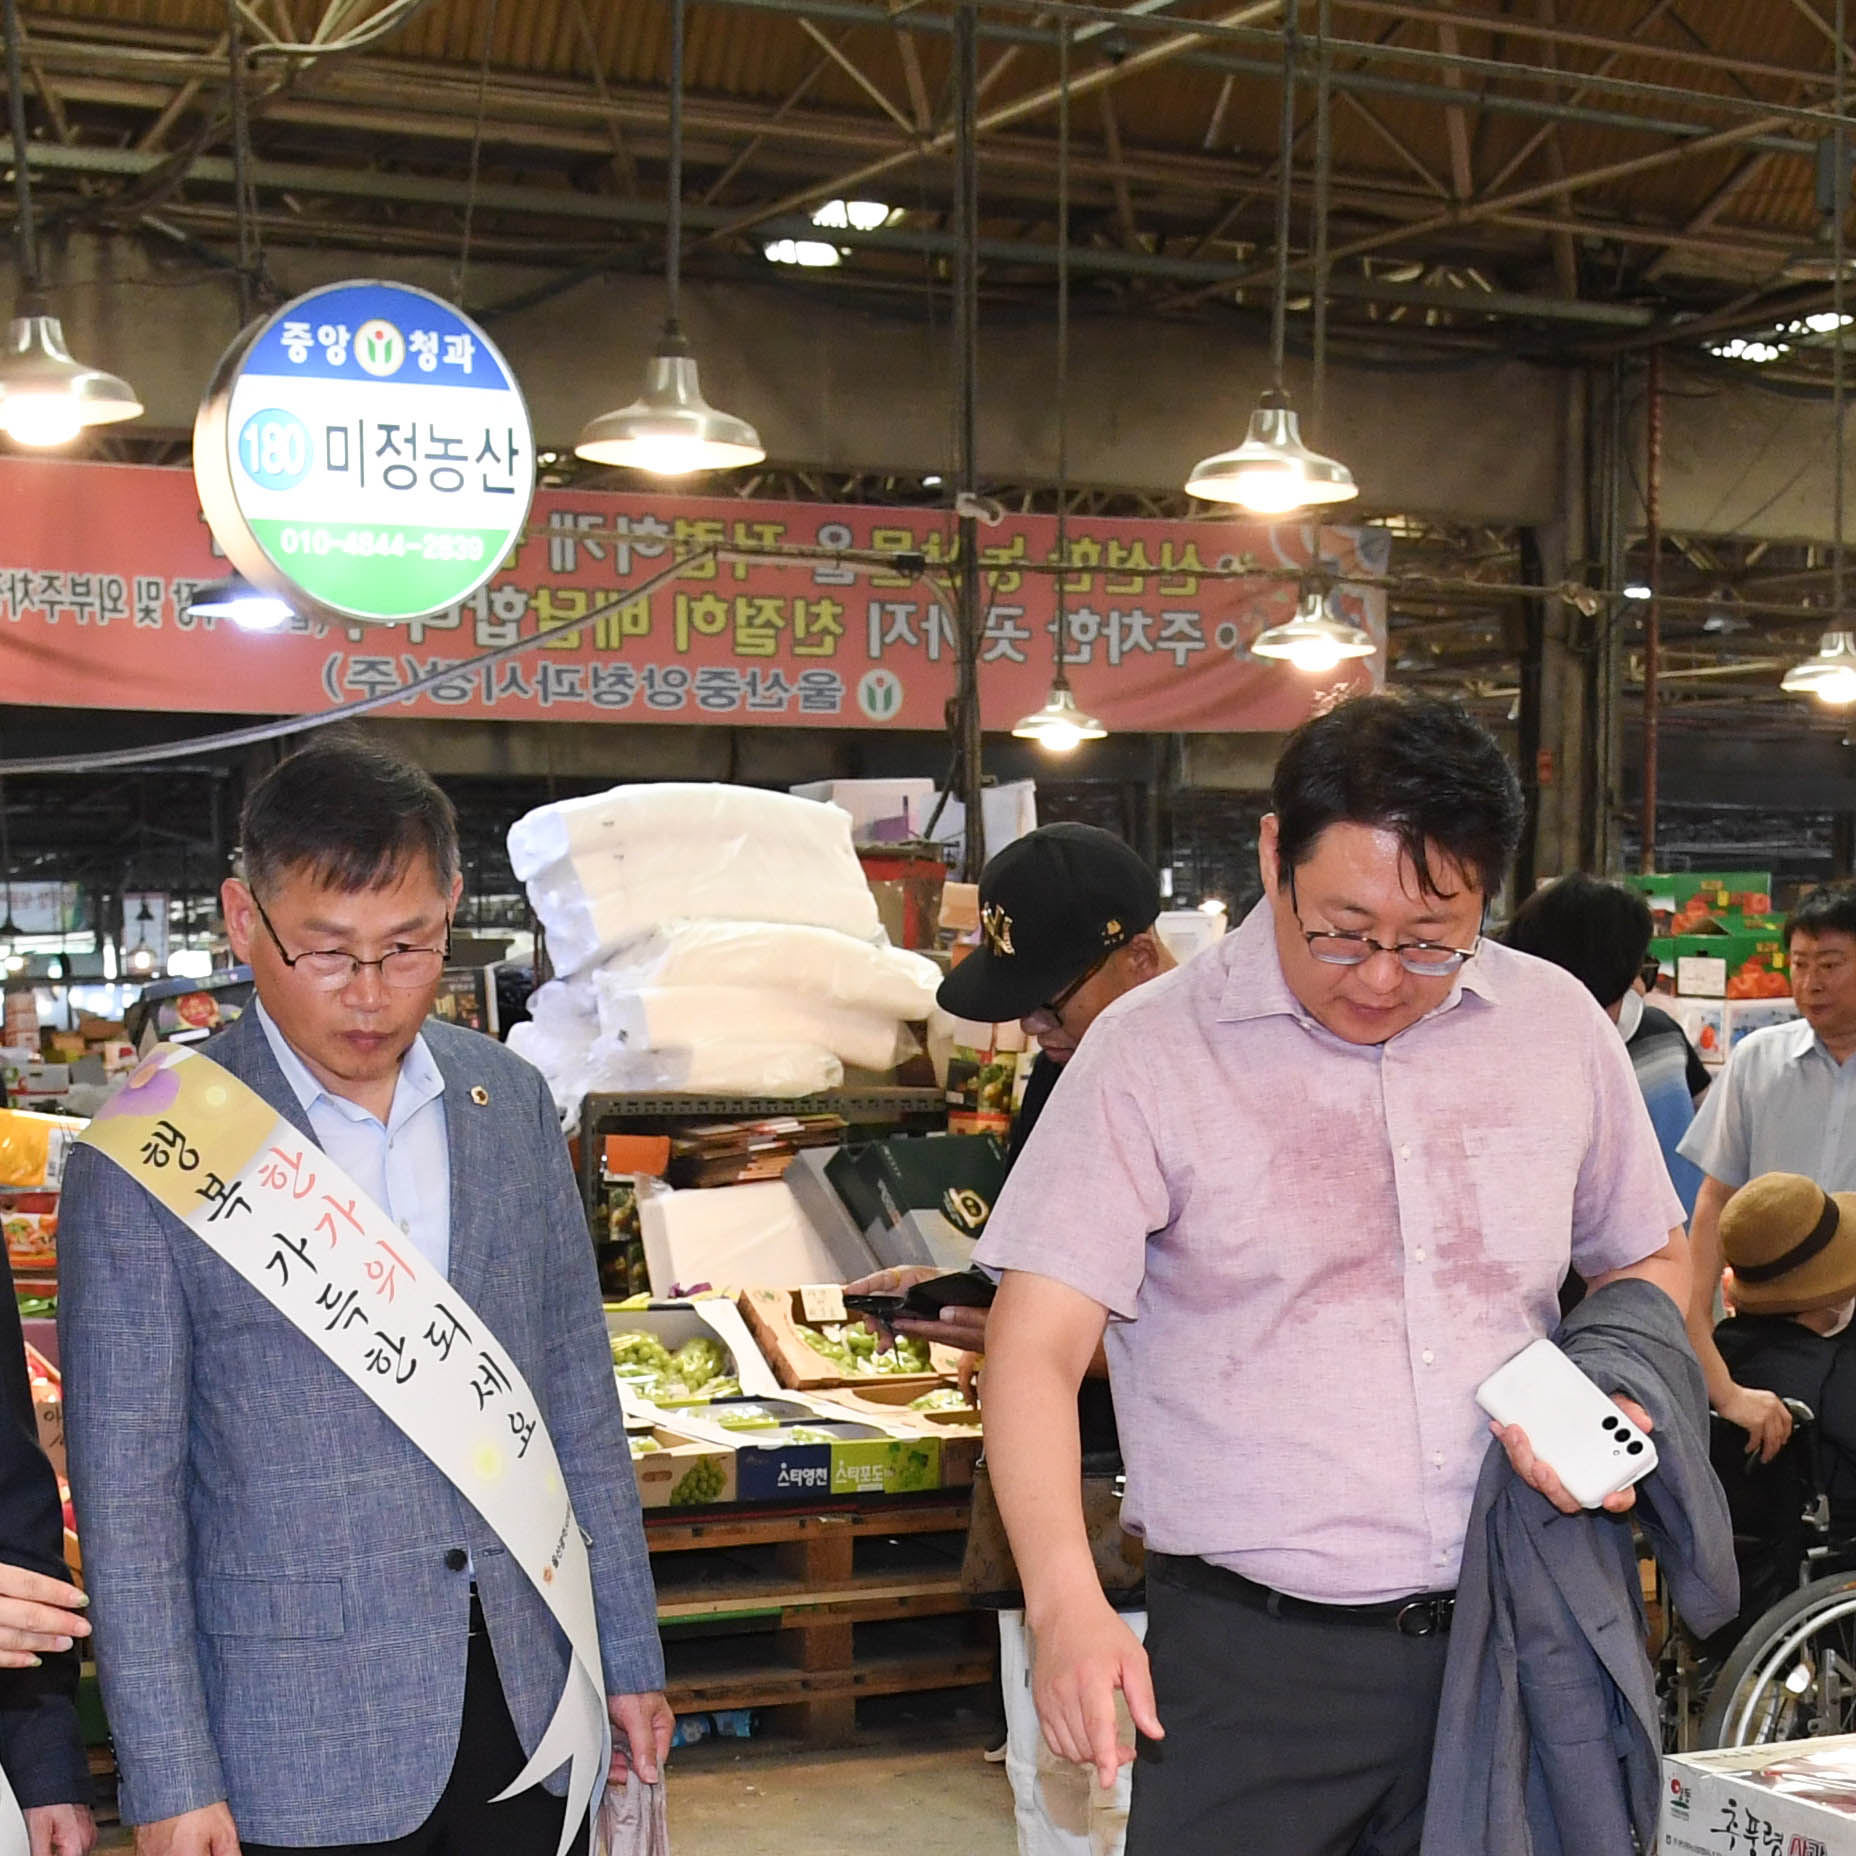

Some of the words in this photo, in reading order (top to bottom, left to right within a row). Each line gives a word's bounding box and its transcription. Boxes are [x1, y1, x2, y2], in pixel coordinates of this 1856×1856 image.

[281, 322, 350, 366] 중앙
[409, 330, 475, 374] 청과
[244, 422, 305, 476] 180
[326, 419, 519, 495] 미정농산
[140, 1120, 254, 1225] 행복
[265, 1232, 418, 1386] 가득한
[257, 1146, 417, 1304] 한가위
[424, 1302, 538, 1460] 되세요
